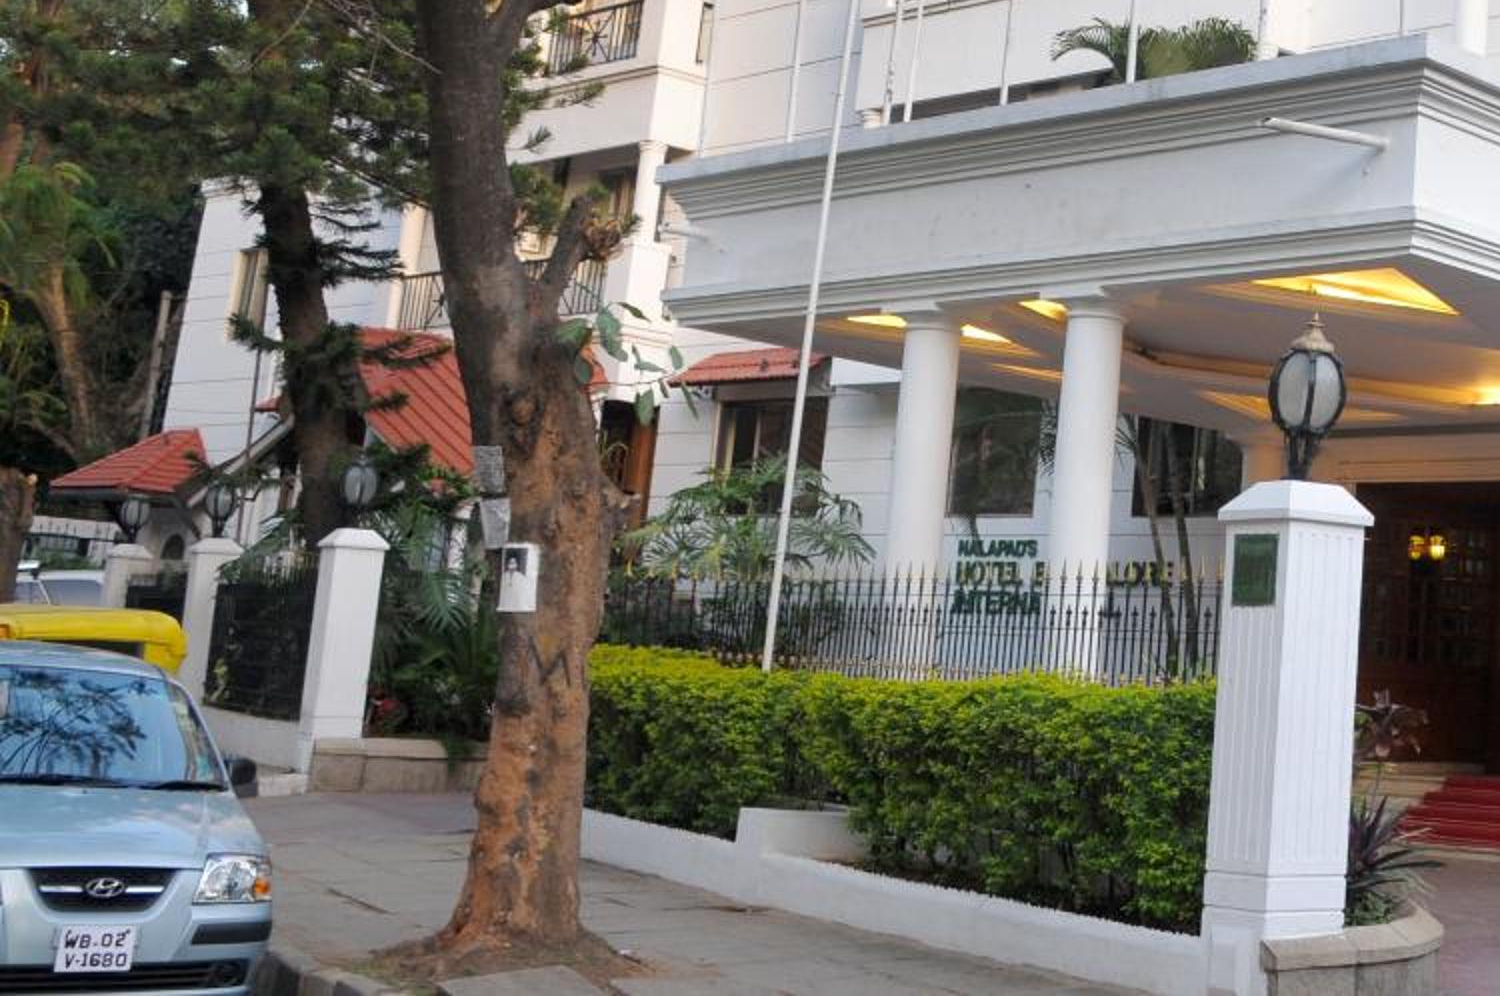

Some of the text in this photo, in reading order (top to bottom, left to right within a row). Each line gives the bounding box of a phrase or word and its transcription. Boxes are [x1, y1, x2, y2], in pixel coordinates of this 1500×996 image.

[957, 539, 1038, 558] NALAPAD'S
[955, 561, 1023, 586] HOTEL
[65, 952, 128, 969] V-1680
